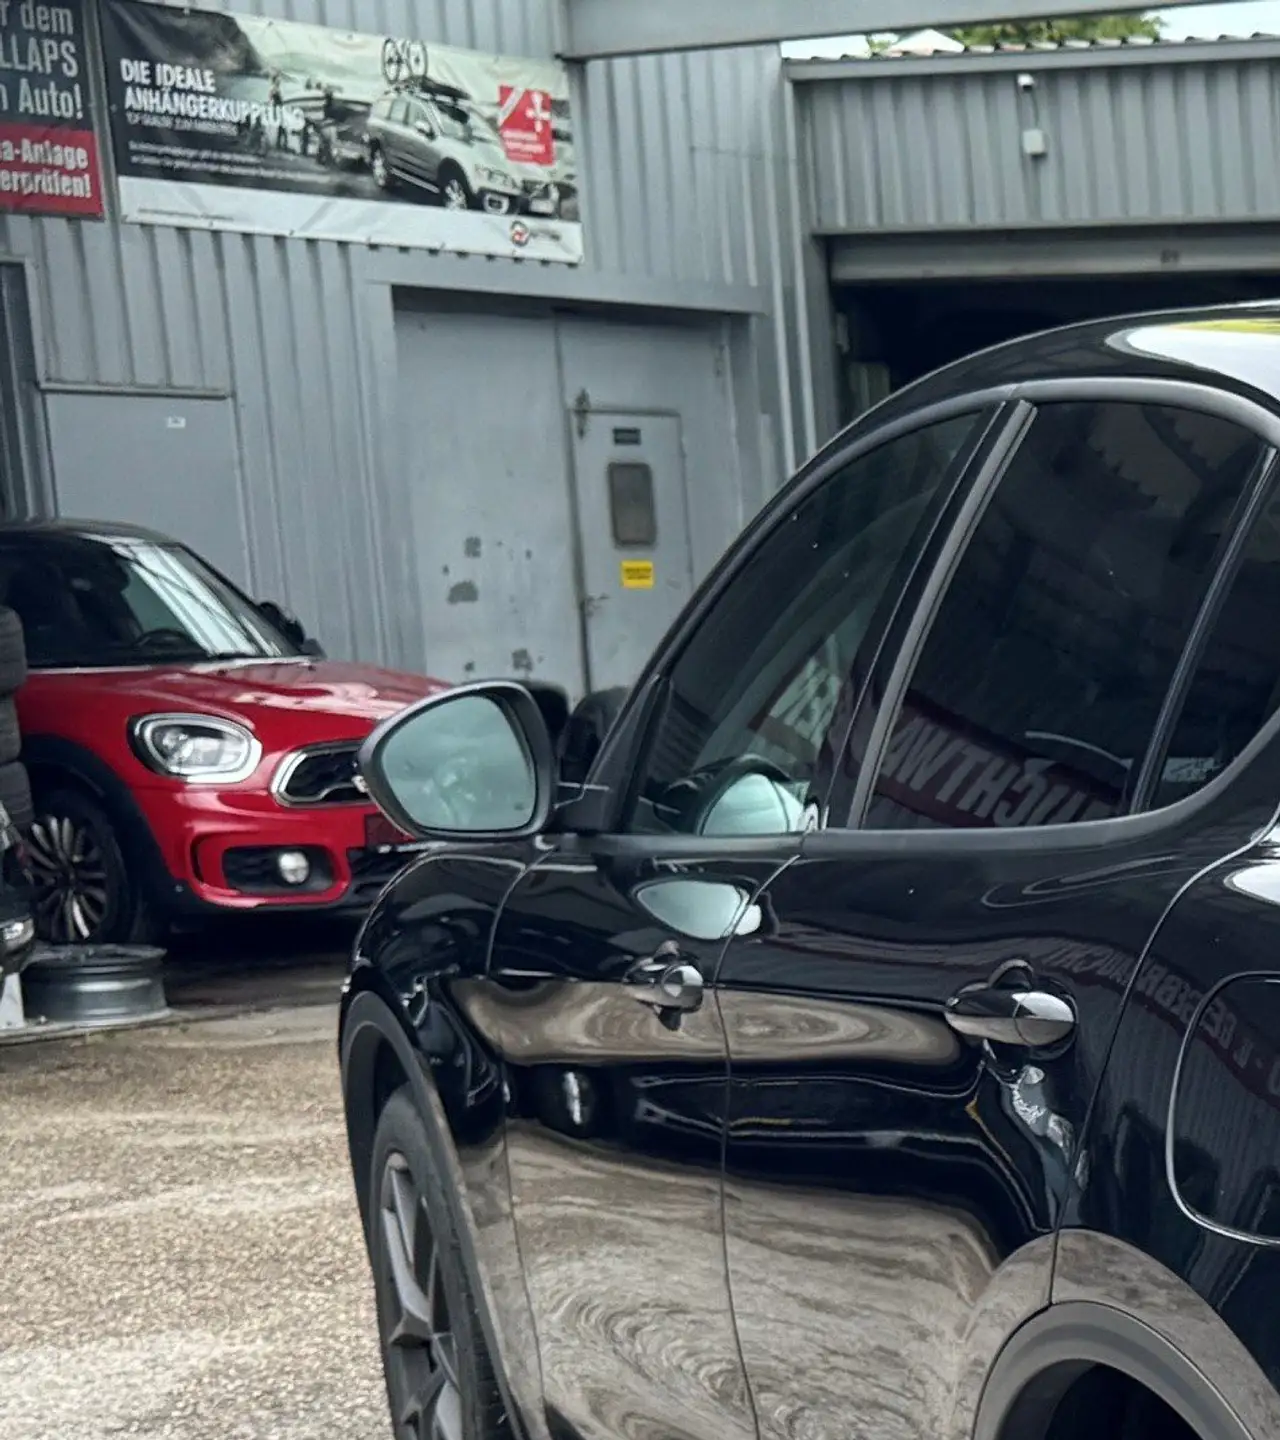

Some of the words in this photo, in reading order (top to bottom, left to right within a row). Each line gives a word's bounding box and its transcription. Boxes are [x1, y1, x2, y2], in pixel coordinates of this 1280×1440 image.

[20, 0, 74, 35] dem
[120, 58, 151, 85] DIE
[155, 63, 216, 93] IDEALE
[19, 77, 84, 120] Auto!
[124, 86, 306, 132] ANHÄNGERKUPPLUNG
